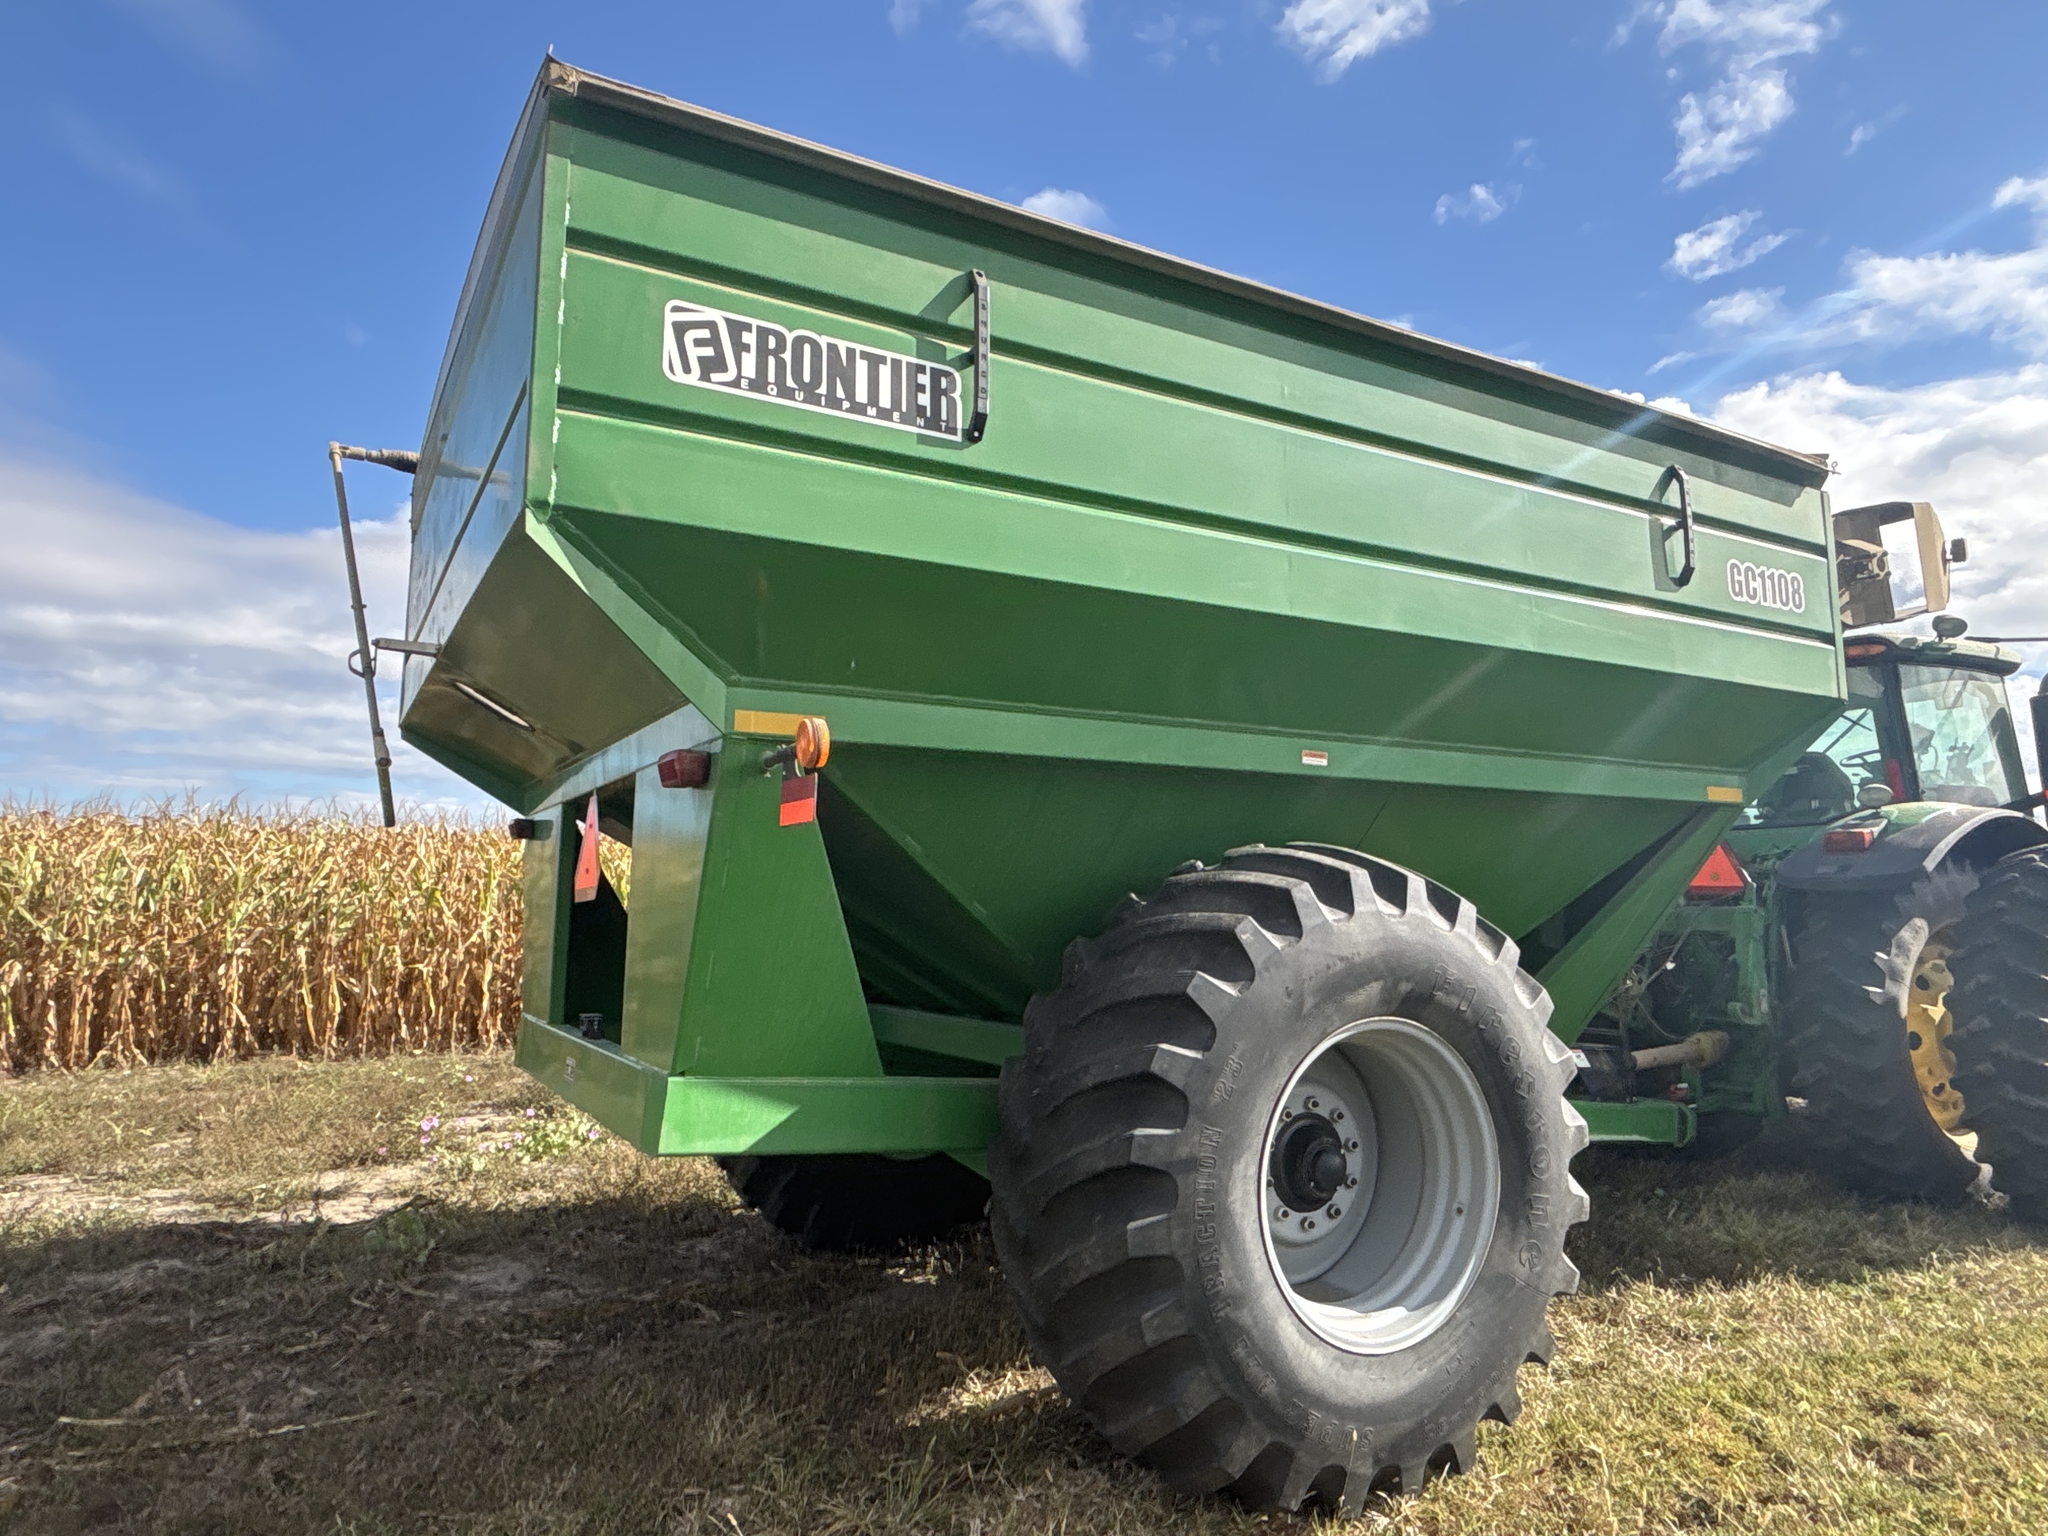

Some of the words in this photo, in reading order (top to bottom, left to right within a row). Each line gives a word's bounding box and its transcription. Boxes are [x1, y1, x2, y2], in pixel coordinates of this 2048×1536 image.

[724, 316, 959, 424] FRONTIER
[740, 377, 947, 432] EQUIPMENT
[1729, 561, 1804, 611] GC1108
[1194, 1126, 1232, 1323] TRACTION
[1284, 1398, 1374, 1452] SUPER
